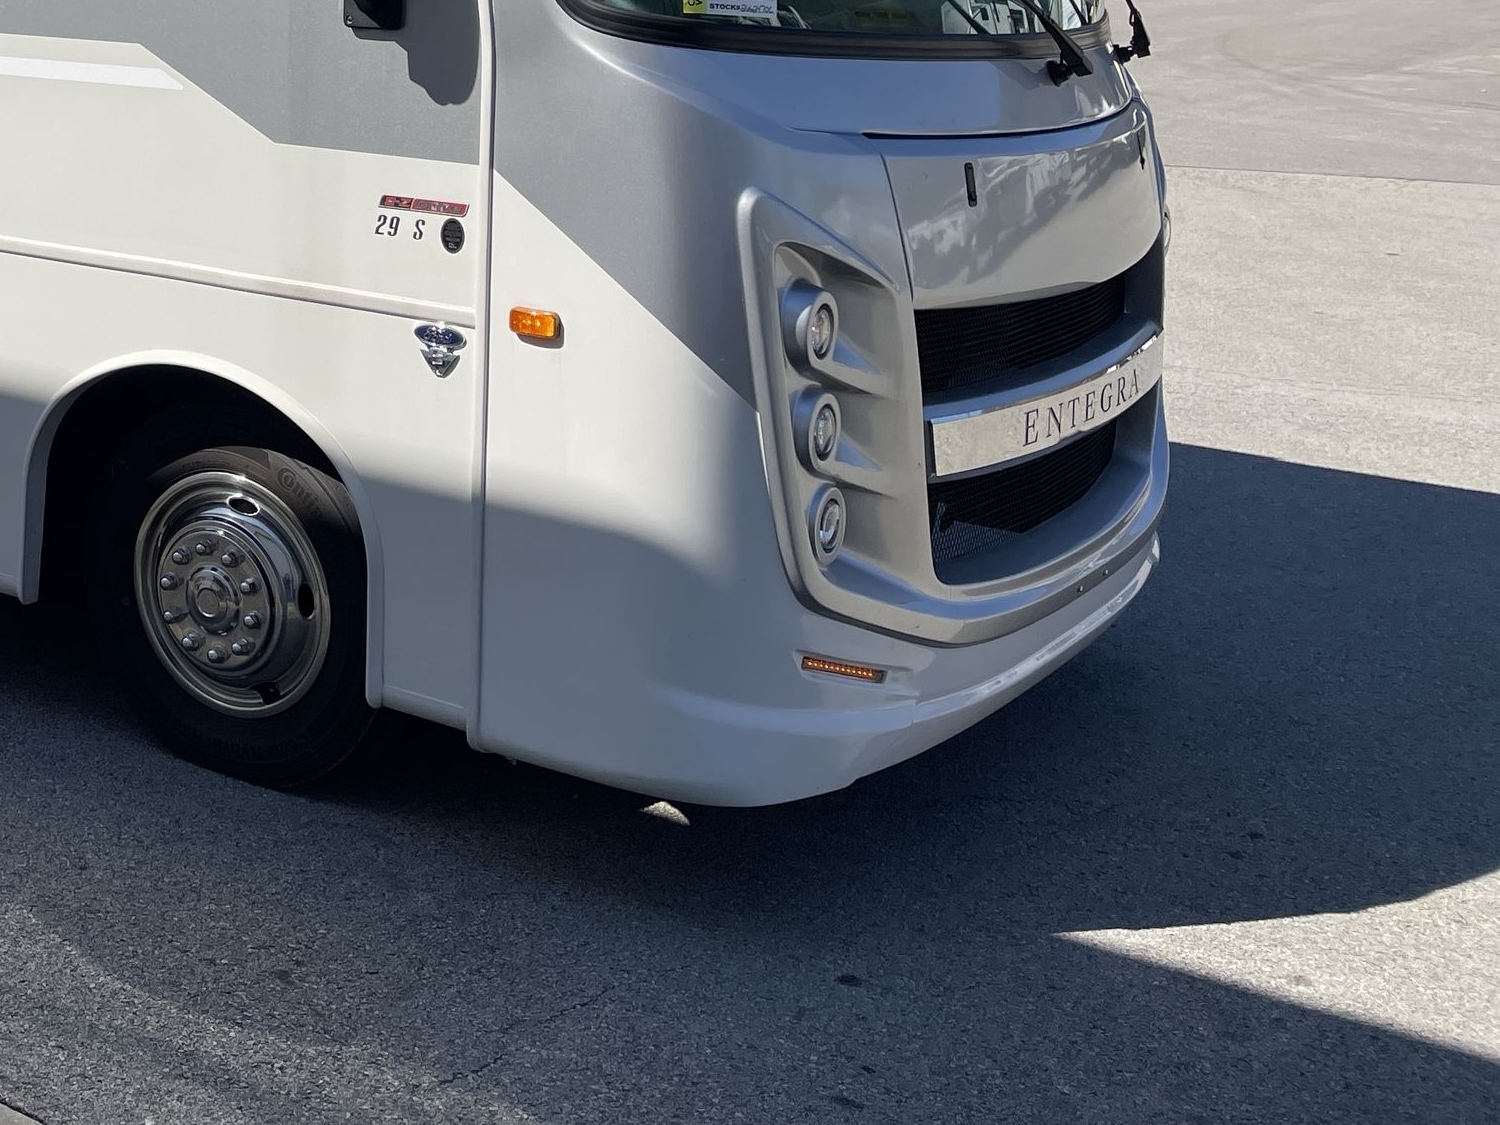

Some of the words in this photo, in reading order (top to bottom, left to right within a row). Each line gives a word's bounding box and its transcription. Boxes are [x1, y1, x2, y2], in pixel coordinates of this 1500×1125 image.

[709, 3, 741, 11] STOCK#
[375, 214, 401, 237] 29
[412, 219, 426, 240] S
[1022, 368, 1140, 447] ENTEGRA
